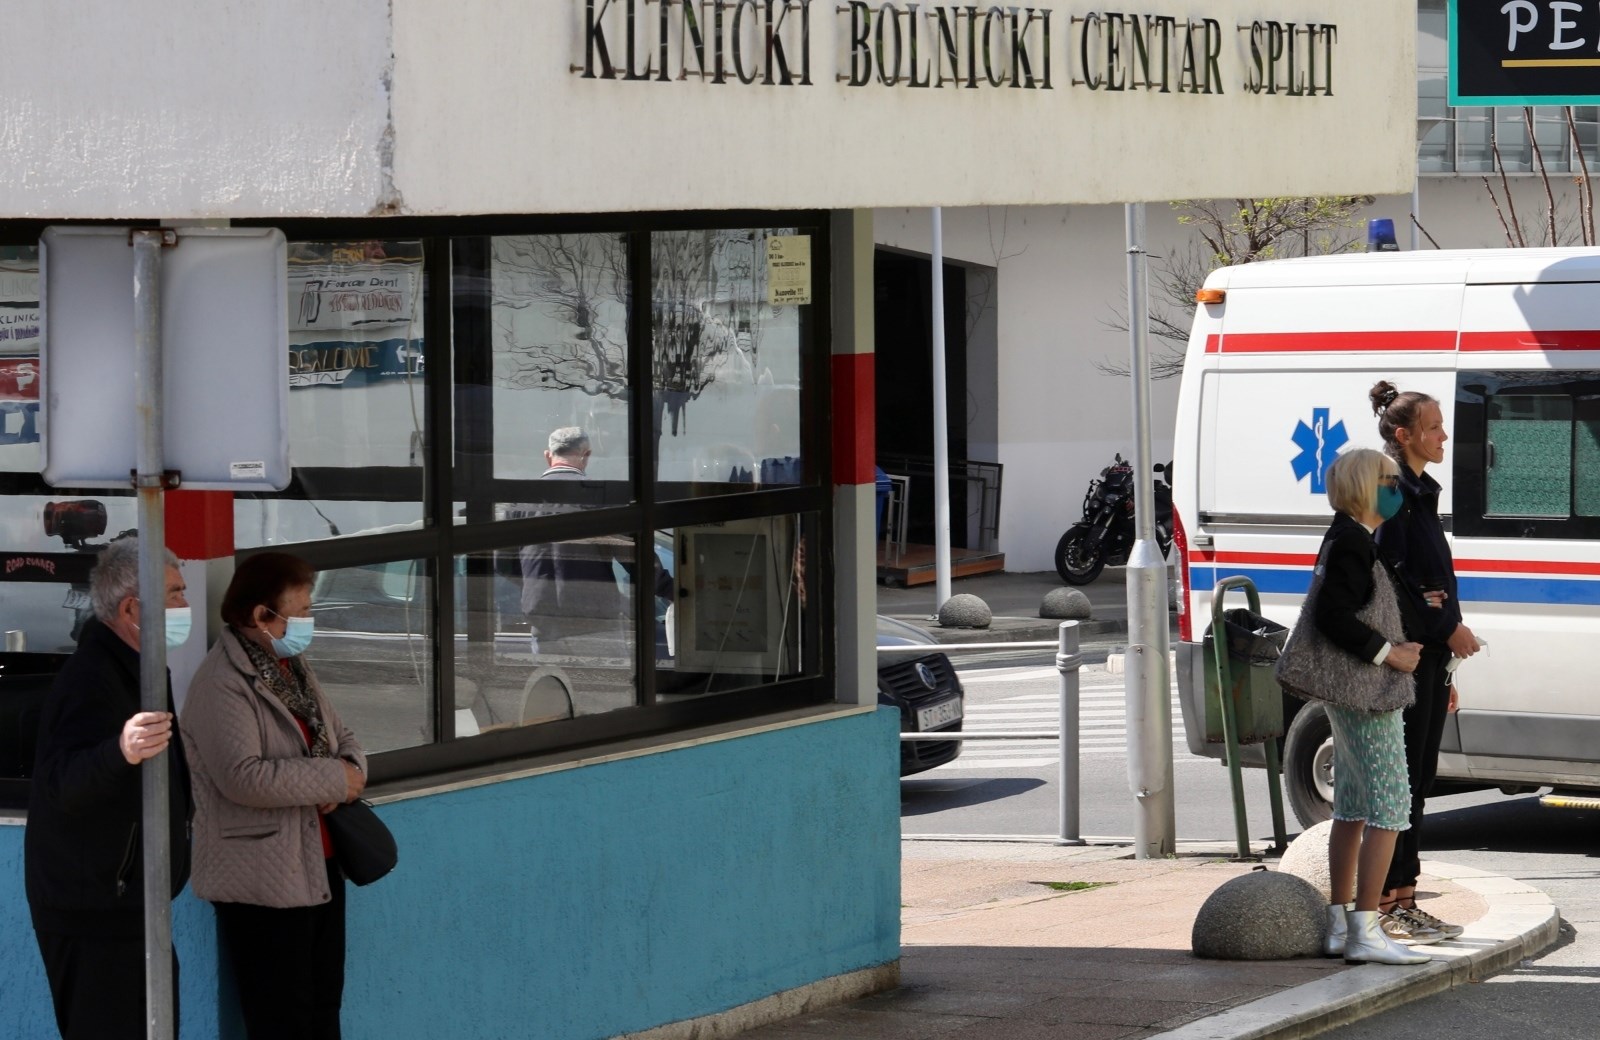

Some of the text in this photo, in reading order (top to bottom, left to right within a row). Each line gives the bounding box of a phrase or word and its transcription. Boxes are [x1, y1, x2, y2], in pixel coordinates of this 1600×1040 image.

[847, 0, 1053, 90] BOLNICKI
[1080, 11, 1225, 95] CENTAR
[1248, 19, 1338, 97] SPLIT
[1500, 0, 1600, 52] PE
